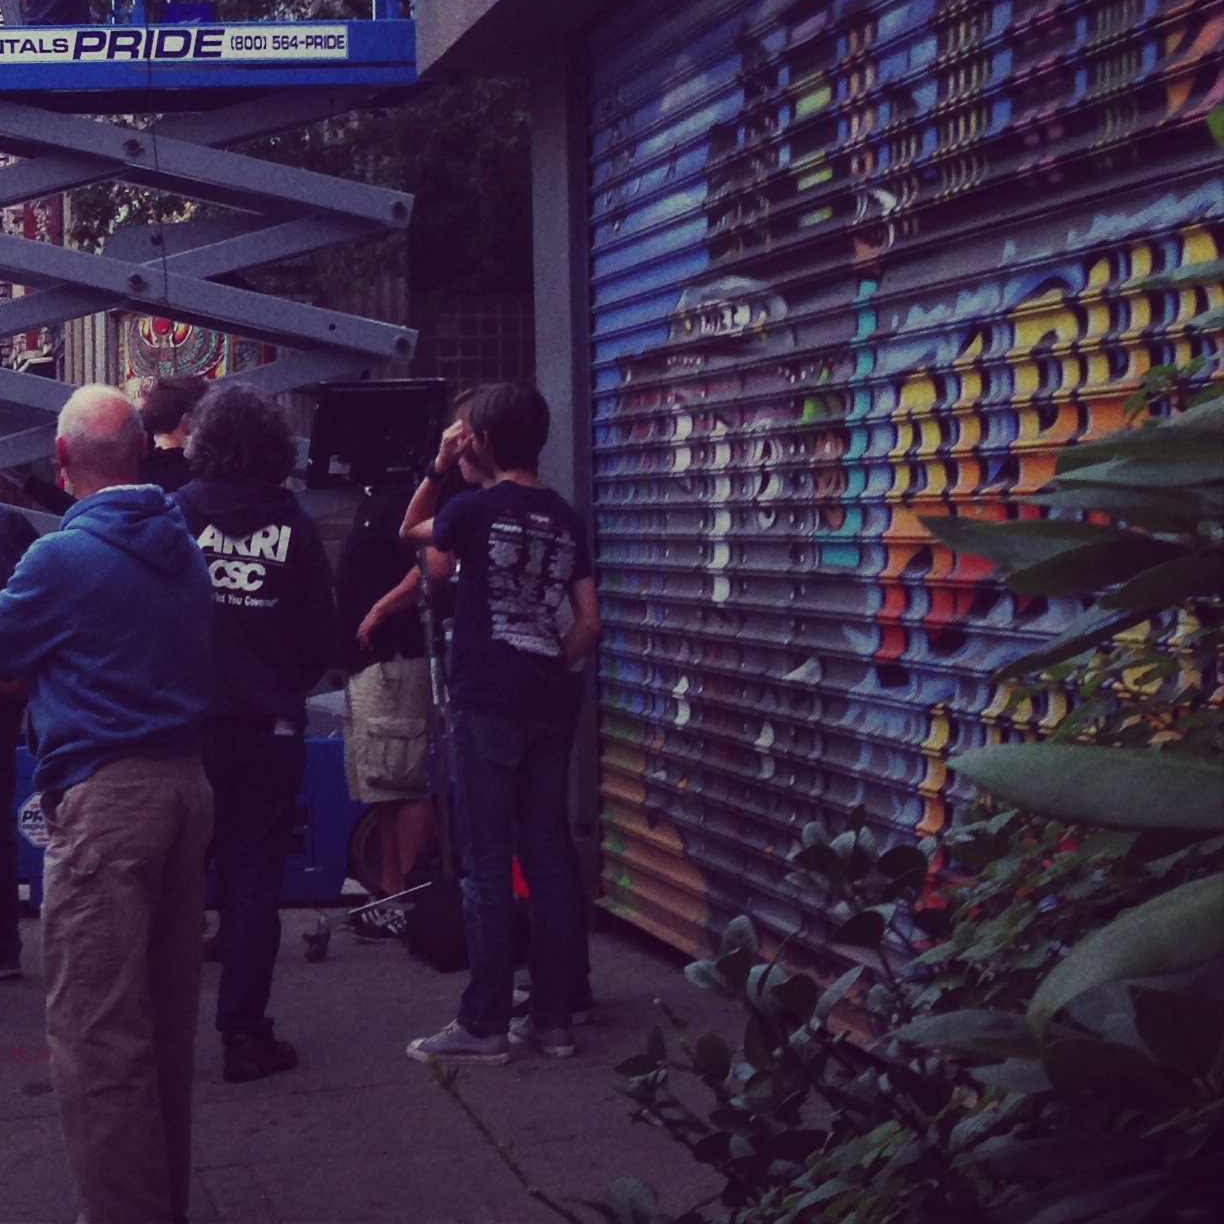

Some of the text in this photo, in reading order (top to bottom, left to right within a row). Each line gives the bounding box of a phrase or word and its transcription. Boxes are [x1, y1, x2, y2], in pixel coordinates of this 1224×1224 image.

[72, 29, 225, 61] PRIDE
[230, 35, 267, 51] (800)
[272, 34, 345, 50] 564-PRIDE
[209, 559, 266, 592] CSC
